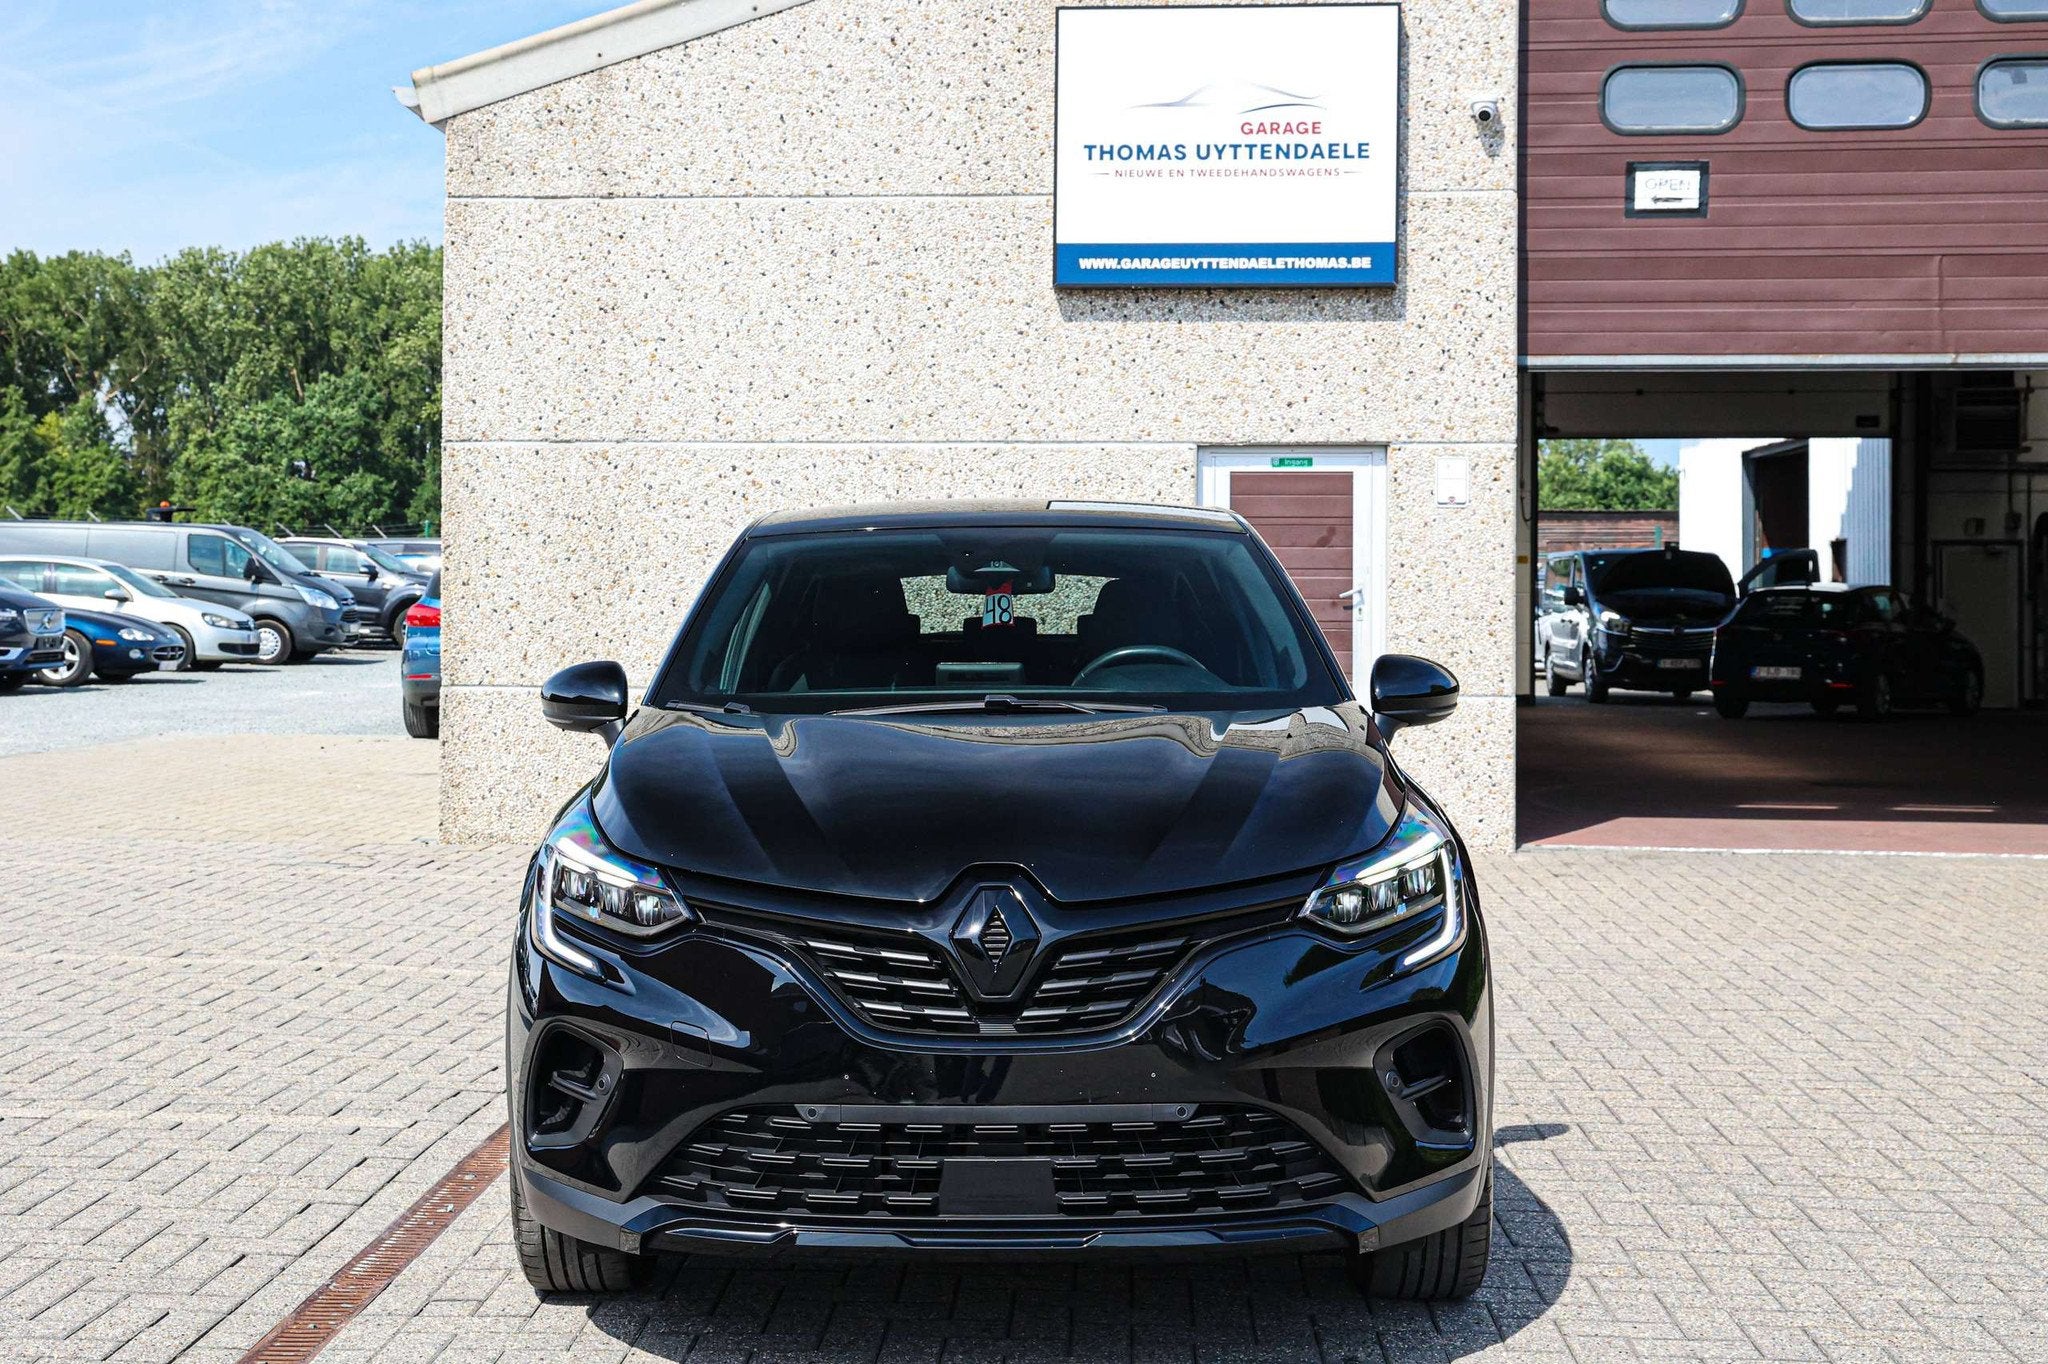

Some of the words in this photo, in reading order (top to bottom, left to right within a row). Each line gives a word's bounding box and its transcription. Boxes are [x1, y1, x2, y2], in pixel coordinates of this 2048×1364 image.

[1240, 121, 1322, 135] GARAGE
[1083, 144, 1187, 161] THOMAS
[1196, 142, 1370, 161] UYTTENDAELE
[1114, 169, 1163, 178] NIEUWE
[1168, 169, 1185, 178] EN
[1189, 168, 1341, 178] TWEEDEHANDSWAGENS
[1078, 256, 1372, 271] WWW.GARAGEUYTTENDAELETHOMAS.BE
[985, 594, 1012, 625] 48
